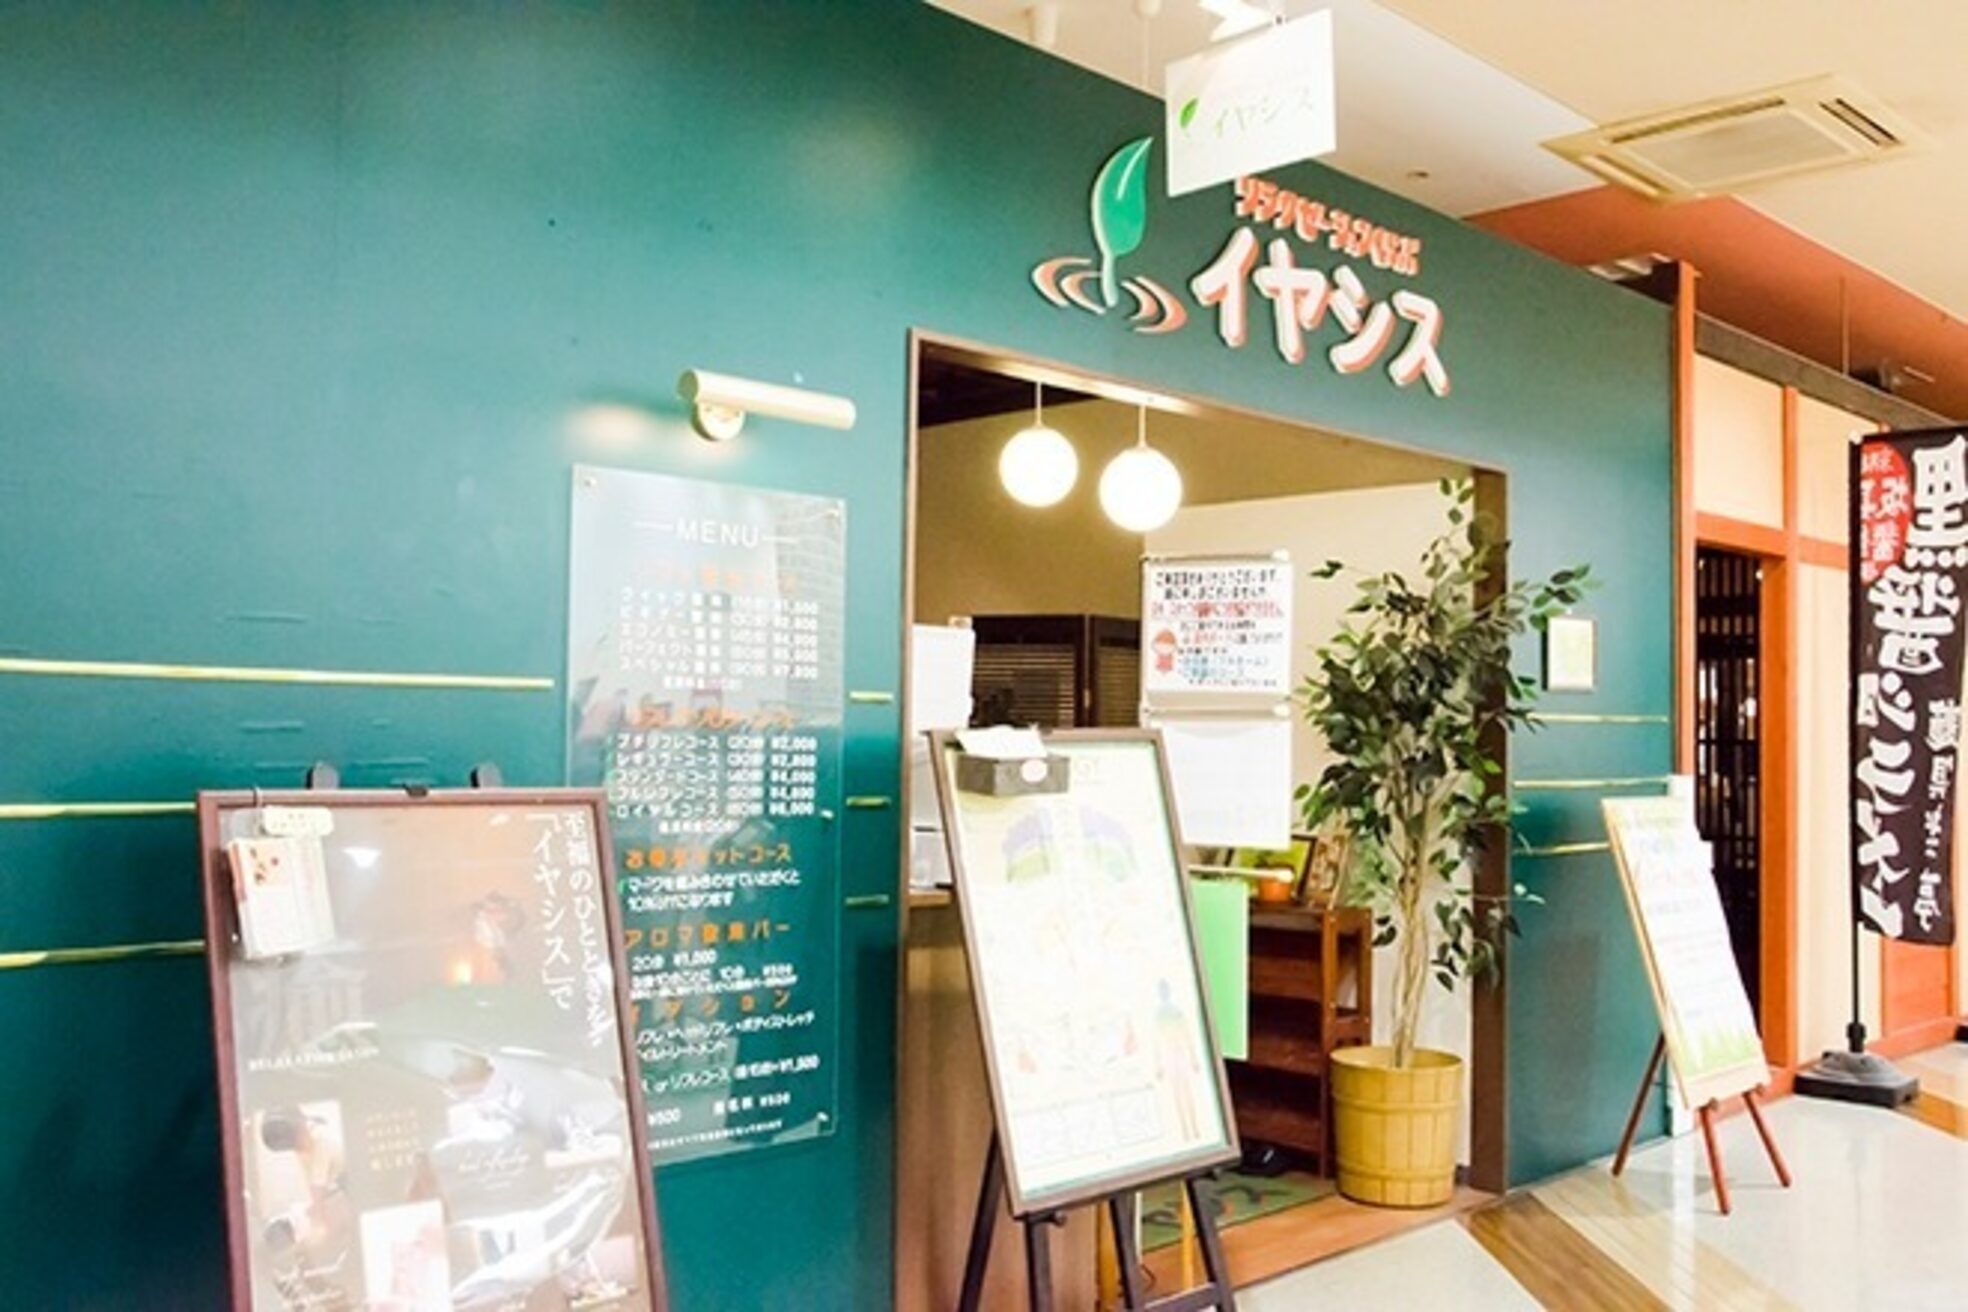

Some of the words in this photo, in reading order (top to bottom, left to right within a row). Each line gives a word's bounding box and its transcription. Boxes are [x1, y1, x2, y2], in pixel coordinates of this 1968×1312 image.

[1189, 226, 1450, 396] イヤシス
[677, 517, 759, 547] MENU
[524, 812, 576, 1011] 「イヤシス」で
